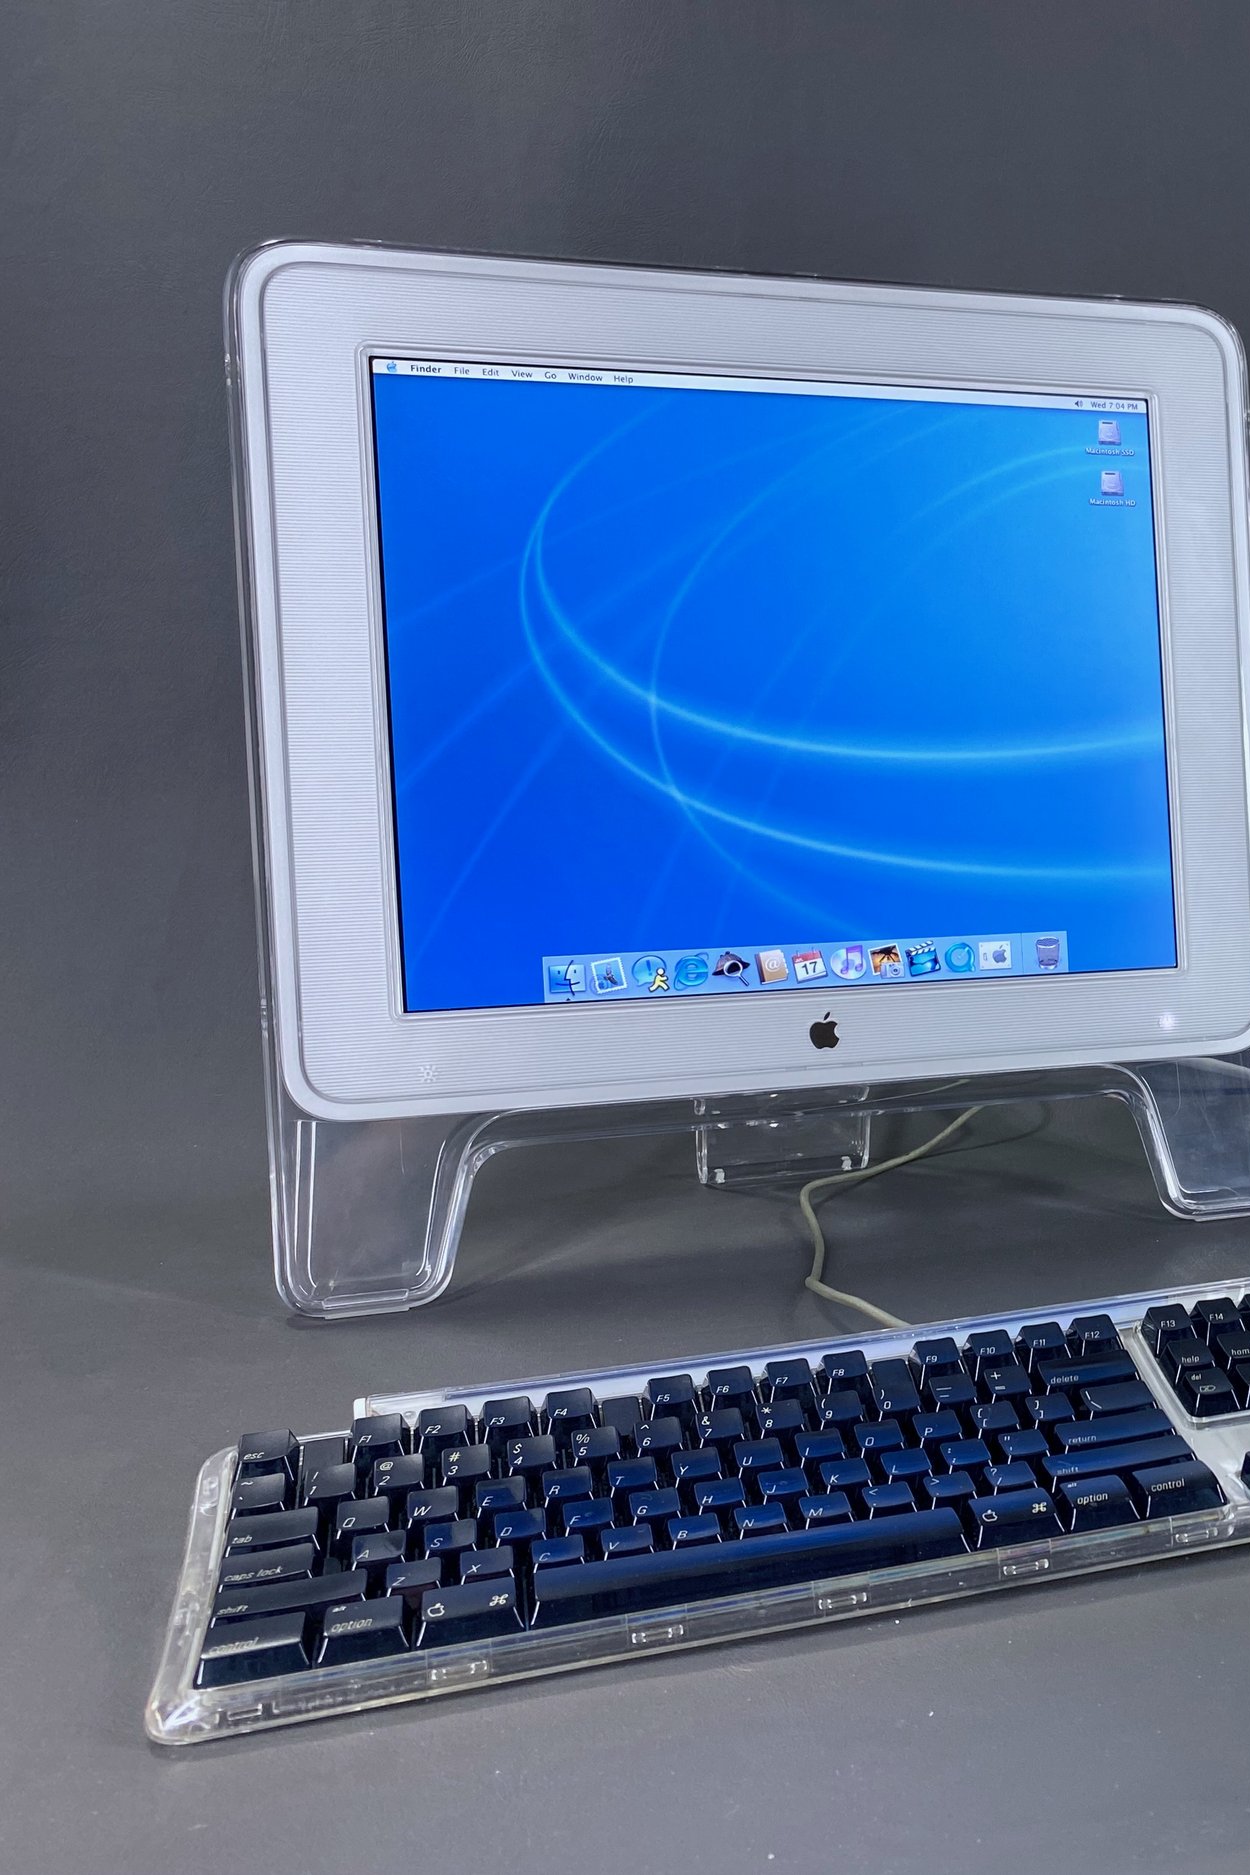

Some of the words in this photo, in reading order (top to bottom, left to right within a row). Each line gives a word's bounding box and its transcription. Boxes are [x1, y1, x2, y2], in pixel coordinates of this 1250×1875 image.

[410, 364, 442, 374] Finder
[454, 366, 470, 376] File
[482, 368, 500, 377] Edit
[512, 370, 533, 379] View
[544, 371, 557, 380] Go
[568, 373, 603, 382] Window
[614, 374, 634, 384] Help
[1090, 401, 1106, 409] Wed
[1085, 447, 1119, 456] Macintosh
[1089, 498, 1124, 506] Macintosh
[802, 961, 818, 975] 17
[1209, 1313, 1223, 1321] F14
[1161, 1320, 1176, 1328] F13
[1084, 1330, 1100, 1339] F12
[1033, 1339, 1046, 1347] F11
[980, 1347, 996, 1355] F10
[925, 1355, 938, 1364] F9
[1181, 1354, 1200, 1364] help
[832, 1368, 845, 1377] F8
[1191, 1373, 1201, 1381] del
[776, 1377, 789, 1385] F7
[1050, 1374, 1080, 1384] delete
[717, 1385, 729, 1393] F6
[656, 1394, 670, 1402] F5
[554, 1408, 568, 1417] F4
[825, 1411, 833, 1419] 9
[490, 1417, 505, 1425] F3
[701, 1416, 710, 1425] &
[765, 1419, 773, 1428] 8
[425, 1424, 441, 1434] F2
[705, 1429, 712, 1437] 7
[924, 1427, 933, 1436] P
[359, 1435, 372, 1444] F1
[576, 1434, 590, 1443] %
[642, 1438, 651, 1446] 6
[1068, 1435, 1097, 1445] return
[244, 1451, 264, 1460] esc
[579, 1447, 587, 1456] 5
[450, 1452, 460, 1461] #
[514, 1456, 523, 1465] 4
[743, 1457, 752, 1465] U
[380, 1461, 393, 1471] @
[448, 1465, 458, 1475] 3
[679, 1466, 688, 1475] Y
[891, 1465, 899, 1473] L
[1057, 1465, 1080, 1475] shift
[311, 1471, 319, 1482] !
[990, 1467, 997, 1478] ?
[379, 1476, 390, 1485] 2
[615, 1476, 623, 1485] T
[829, 1475, 838, 1483] K
[767, 1485, 776, 1494] J
[1151, 1478, 1185, 1492] control
[310, 1486, 317, 1495] 1
[549, 1486, 560, 1495] R
[482, 1496, 493, 1506] E
[702, 1495, 713, 1504] H
[1077, 1492, 1108, 1505] option
[414, 1506, 431, 1516] W
[637, 1505, 648, 1515] G
[808, 1508, 823, 1516] M
[342, 1517, 356, 1527] Q
[570, 1516, 581, 1525] F
[743, 1519, 755, 1527] N
[500, 1527, 512, 1536] D
[677, 1531, 688, 1539] B
[232, 1535, 252, 1544] tab
[431, 1538, 443, 1547] S
[608, 1542, 620, 1550] V
[357, 1550, 369, 1559] A
[539, 1553, 550, 1562] C
[224, 1569, 255, 1581] caps
[257, 1565, 283, 1577] lock
[467, 1564, 481, 1574] X
[392, 1577, 406, 1586] Z
[217, 1604, 248, 1615] shift
[331, 1617, 373, 1633] option
